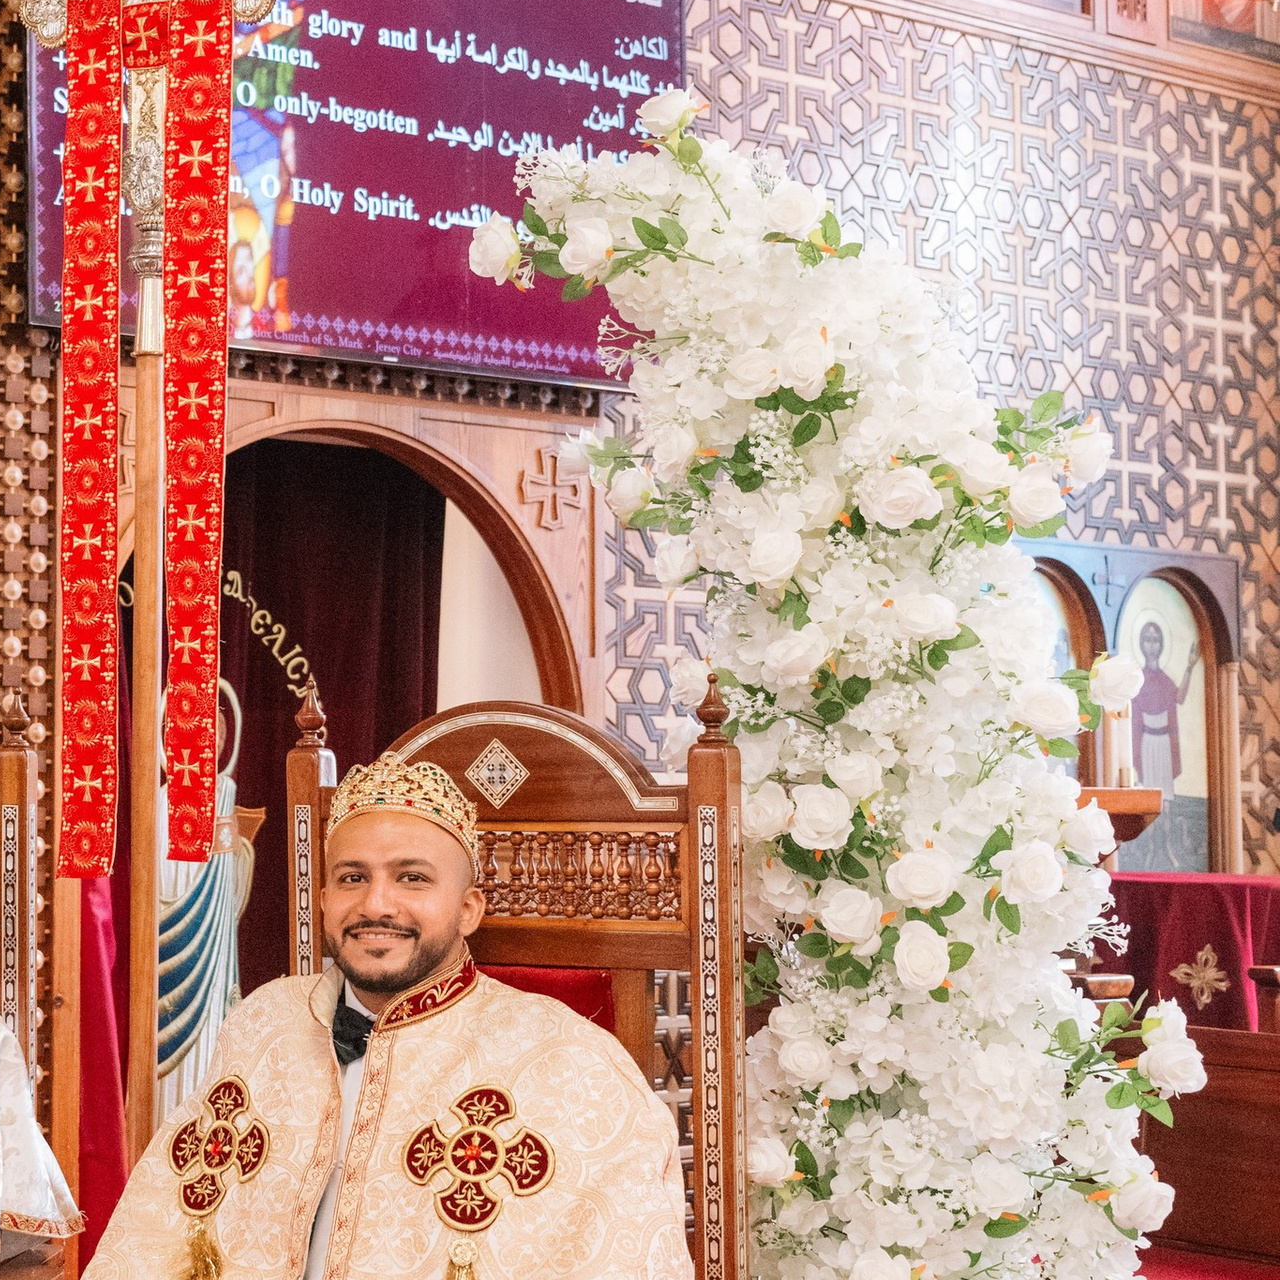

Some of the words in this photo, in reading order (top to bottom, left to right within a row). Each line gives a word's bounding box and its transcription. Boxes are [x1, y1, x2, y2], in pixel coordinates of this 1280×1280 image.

[308, 9, 366, 47] glory
[377, 26, 419, 52] and
[424, 28, 462, 64] أيها
[613, 34, 669, 61] الكاهن:
[247, 34, 320, 70] Amen.
[464, 32, 541, 81] والكرامة
[544, 57, 600, 92] بالمجد
[236, 80, 258, 108] O
[273, 91, 420, 136] only-begotten
[426, 119, 495, 152] الوحيد.
[260, 173, 282, 200] O
[290, 176, 345, 215] Holy
[352, 186, 421, 221] Spirit.
[274, 329, 310, 344] Church
[311, 333, 323, 346] of
[323, 332, 337, 347] St.
[338, 335, 363, 350] Mark
[375, 340, 401, 355] Jersey
[402, 342, 422, 358] City
